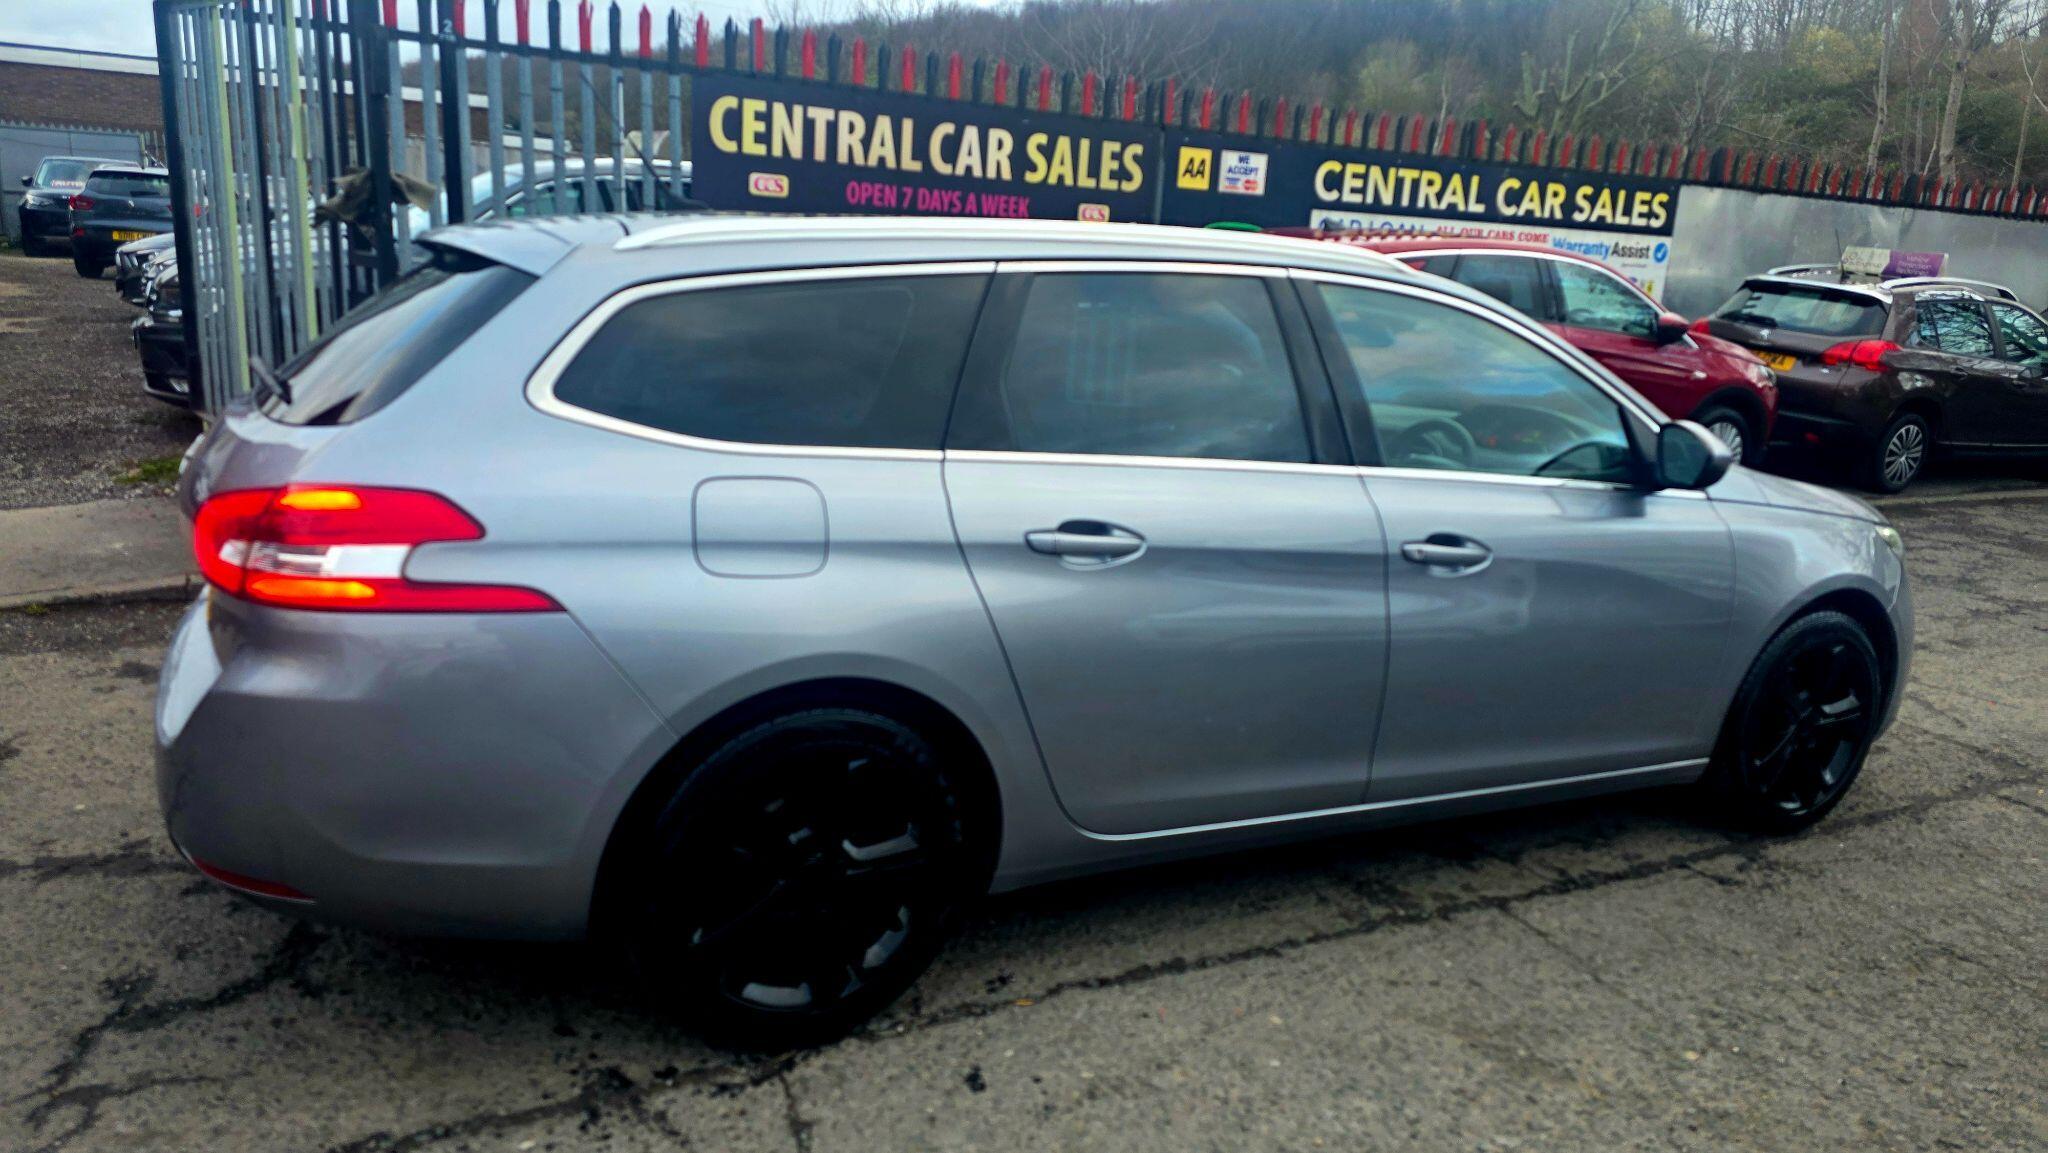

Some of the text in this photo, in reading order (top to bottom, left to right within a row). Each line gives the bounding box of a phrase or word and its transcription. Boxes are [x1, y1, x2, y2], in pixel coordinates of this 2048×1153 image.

[708, 95, 1144, 193] CENTRAL CAR SALES
[1183, 157, 1206, 178] AA
[1238, 155, 1250, 164] WE
[1227, 166, 1259, 176] ACCEPT
[846, 180, 1030, 218] OPEN 7 DAYS A WEEK
[1314, 160, 1670, 229] CENTRAL CAR SALES
[1460, 227, 1484, 238] OUR
[1487, 229, 1515, 241] CARS
[1517, 231, 1550, 243] COME
